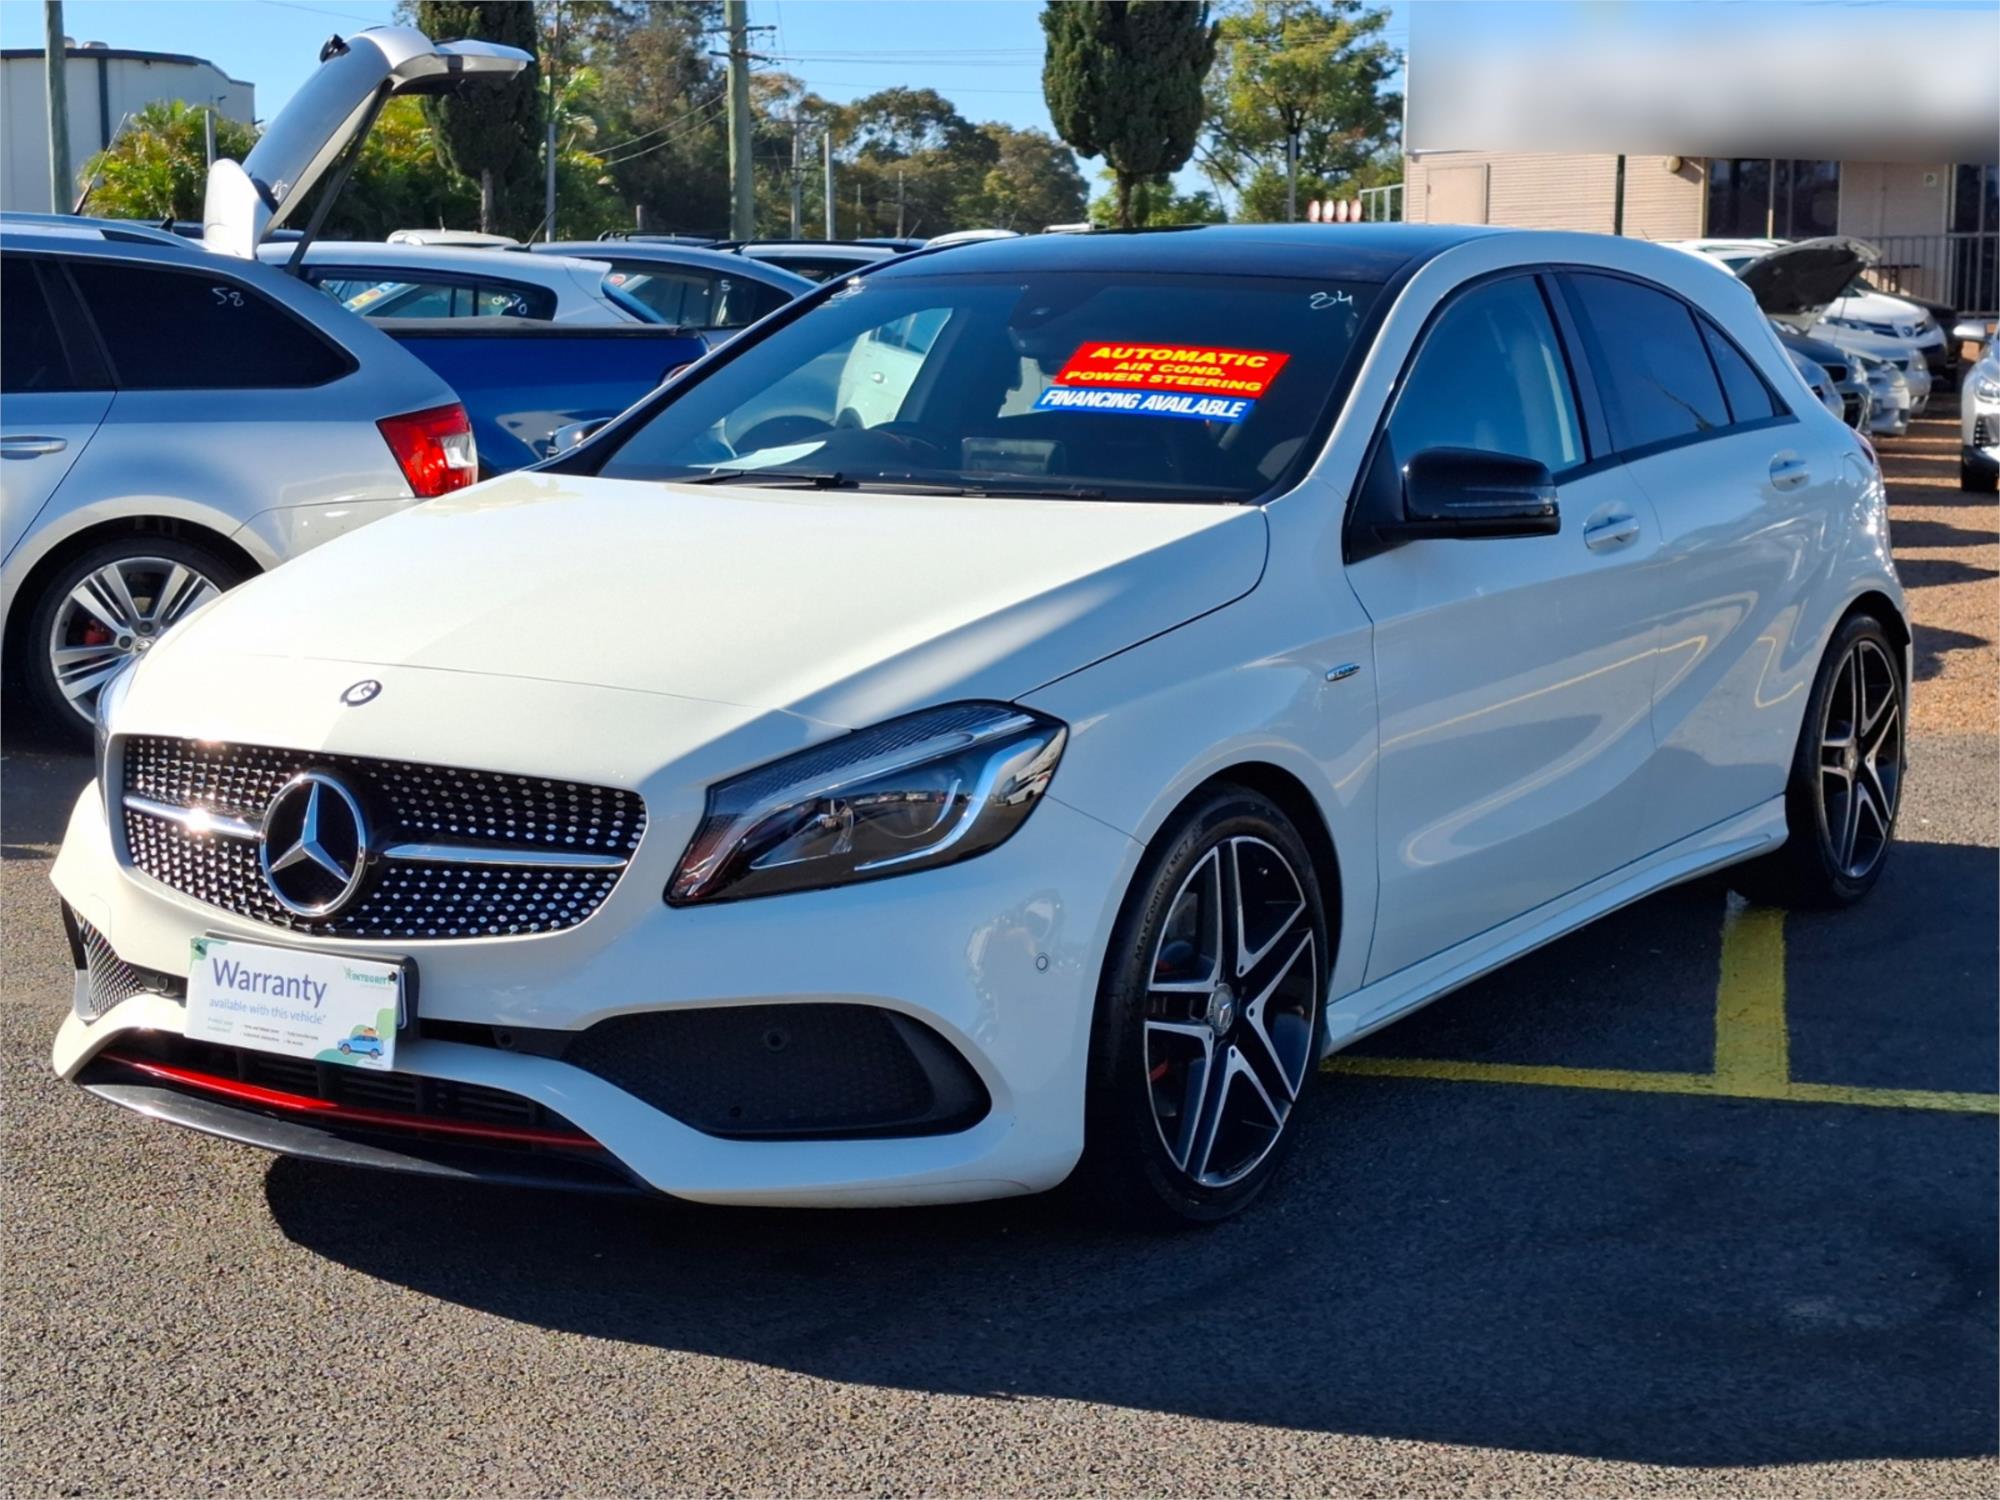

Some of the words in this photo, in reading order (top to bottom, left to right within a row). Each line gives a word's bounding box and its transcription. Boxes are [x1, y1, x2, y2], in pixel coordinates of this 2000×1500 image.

[212, 287, 244, 307] 58
[1309, 290, 1353, 309] 84
[1089, 346, 1269, 368] AUTOMATIC
[1114, 361, 1153, 372] AIR
[1160, 363, 1226, 377] COND.
[1064, 370, 1143, 384] POWER
[1148, 373, 1263, 392] STEERING
[1040, 389, 1141, 410] FINANCING
[1139, 394, 1246, 418] AVAILABLE
[212, 957, 328, 1009] Warranty
[209, 998, 248, 1013] available
[249, 1003, 270, 1016] with
[271, 1006, 288, 1019] this
